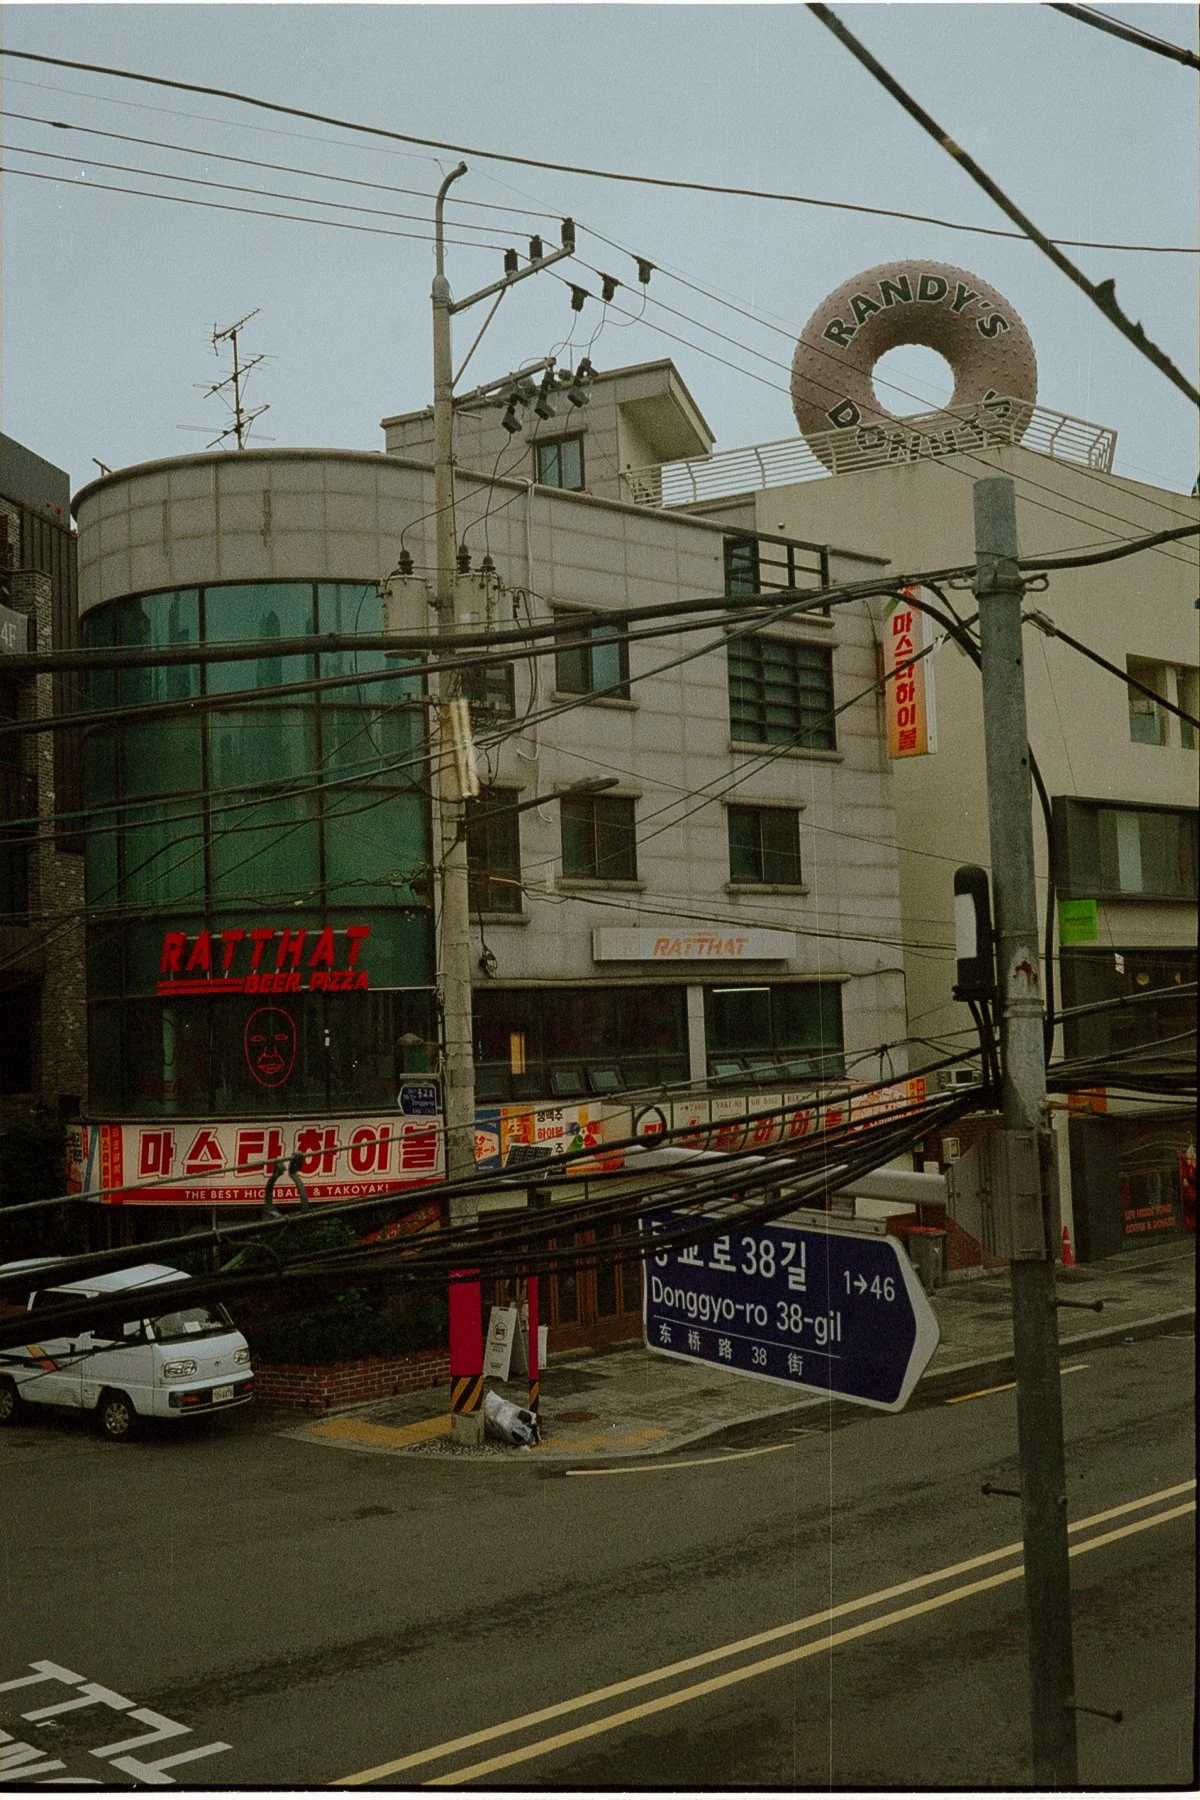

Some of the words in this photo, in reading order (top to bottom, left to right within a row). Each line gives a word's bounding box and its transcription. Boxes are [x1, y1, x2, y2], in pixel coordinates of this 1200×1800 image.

[821, 273, 1010, 350] RANDY'S
[1, 620, 17, 648] 4F
[160, 926, 370, 973] RATTHAT
[653, 936, 749, 956] RATTHAT
[309, 970, 369, 992] PIZZA
[140, 1124, 439, 1178] 마스타하이볼
[184, 1189, 207, 1200] THE
[211, 1189, 240, 1200] BEST
[651, 1276, 768, 1327] Donggyo-ro
[776, 1300, 842, 1346] 38-gil
